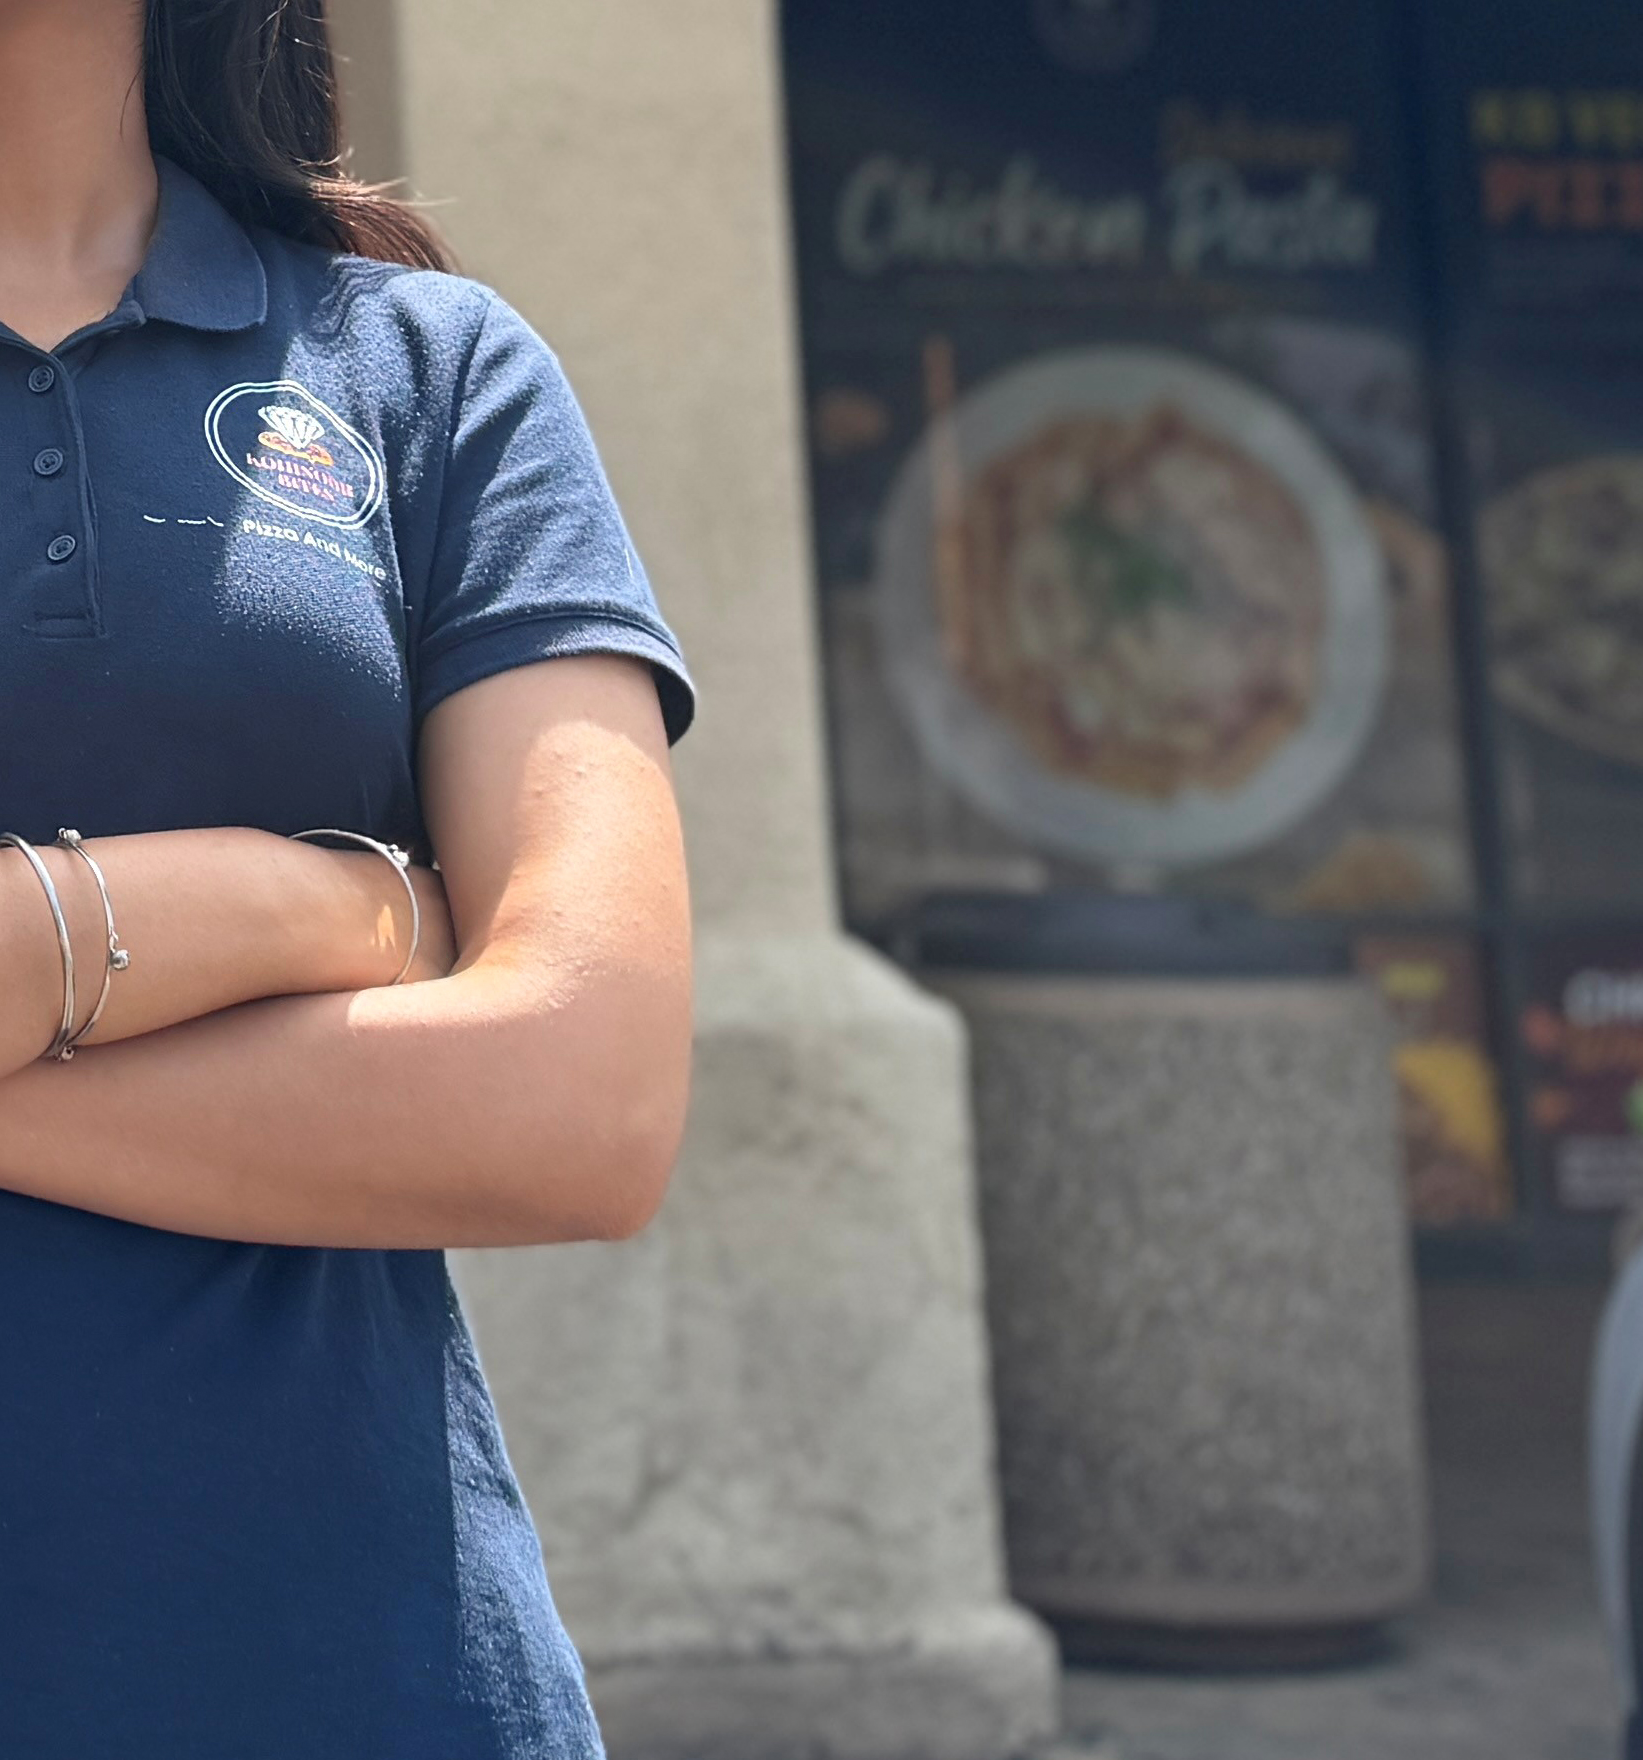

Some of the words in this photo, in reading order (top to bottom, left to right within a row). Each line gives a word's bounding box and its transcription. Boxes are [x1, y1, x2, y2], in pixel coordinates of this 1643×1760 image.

[834, 150, 1151, 277] Chicken
[1166, 155, 1381, 274] Pasta
[241, 518, 300, 542] Pizza
[303, 531, 342, 558] And
